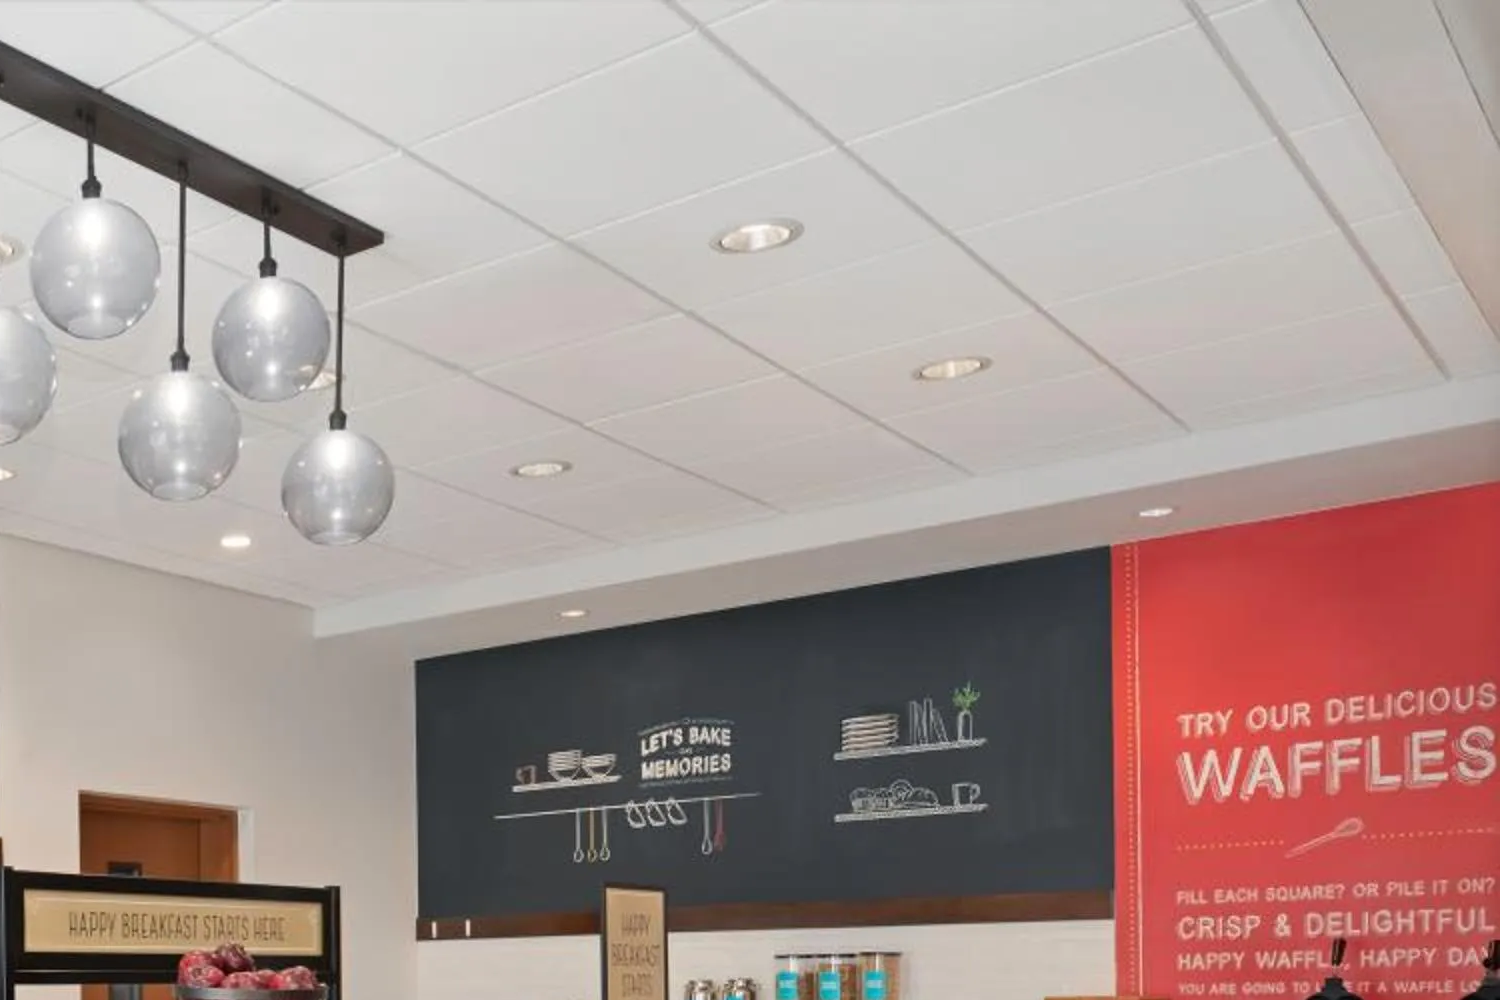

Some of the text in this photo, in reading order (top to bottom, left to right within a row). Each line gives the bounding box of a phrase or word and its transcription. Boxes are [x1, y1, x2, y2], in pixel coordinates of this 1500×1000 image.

[1177, 682, 1497, 738] TRY OUR DELICIOUS
[641, 725, 732, 757] LET'S BAKE
[641, 753, 732, 779] MEMORIES
[1175, 725, 1498, 806] WAFFLES
[1177, 876, 1495, 906] FILL EACH SQUARE? OR PILE IT ON?
[69, 910, 286, 942] HAPPY BREAKFAST STARTS HERE
[621, 911, 651, 938] HAPPY
[1176, 905, 1496, 941] CRISP & DELIGHTFUL
[611, 943, 661, 968] BREAKFAST
[1177, 950, 1245, 971] HAPPY
[1254, 948, 1350, 971] WAFFL,
[1360, 946, 1438, 969] HAPPY
[622, 972, 652, 998] STARTS
[1178, 982, 1204, 996] YOU
[1209, 982, 1237, 996] ARE
[1242, 980, 1286, 995] GOING
[1293, 980, 1311, 994] TO
[1356, 980, 1370, 993] IT
[1377, 980, 1388, 993] A
[1393, 979, 1453, 993] WAFFLE
